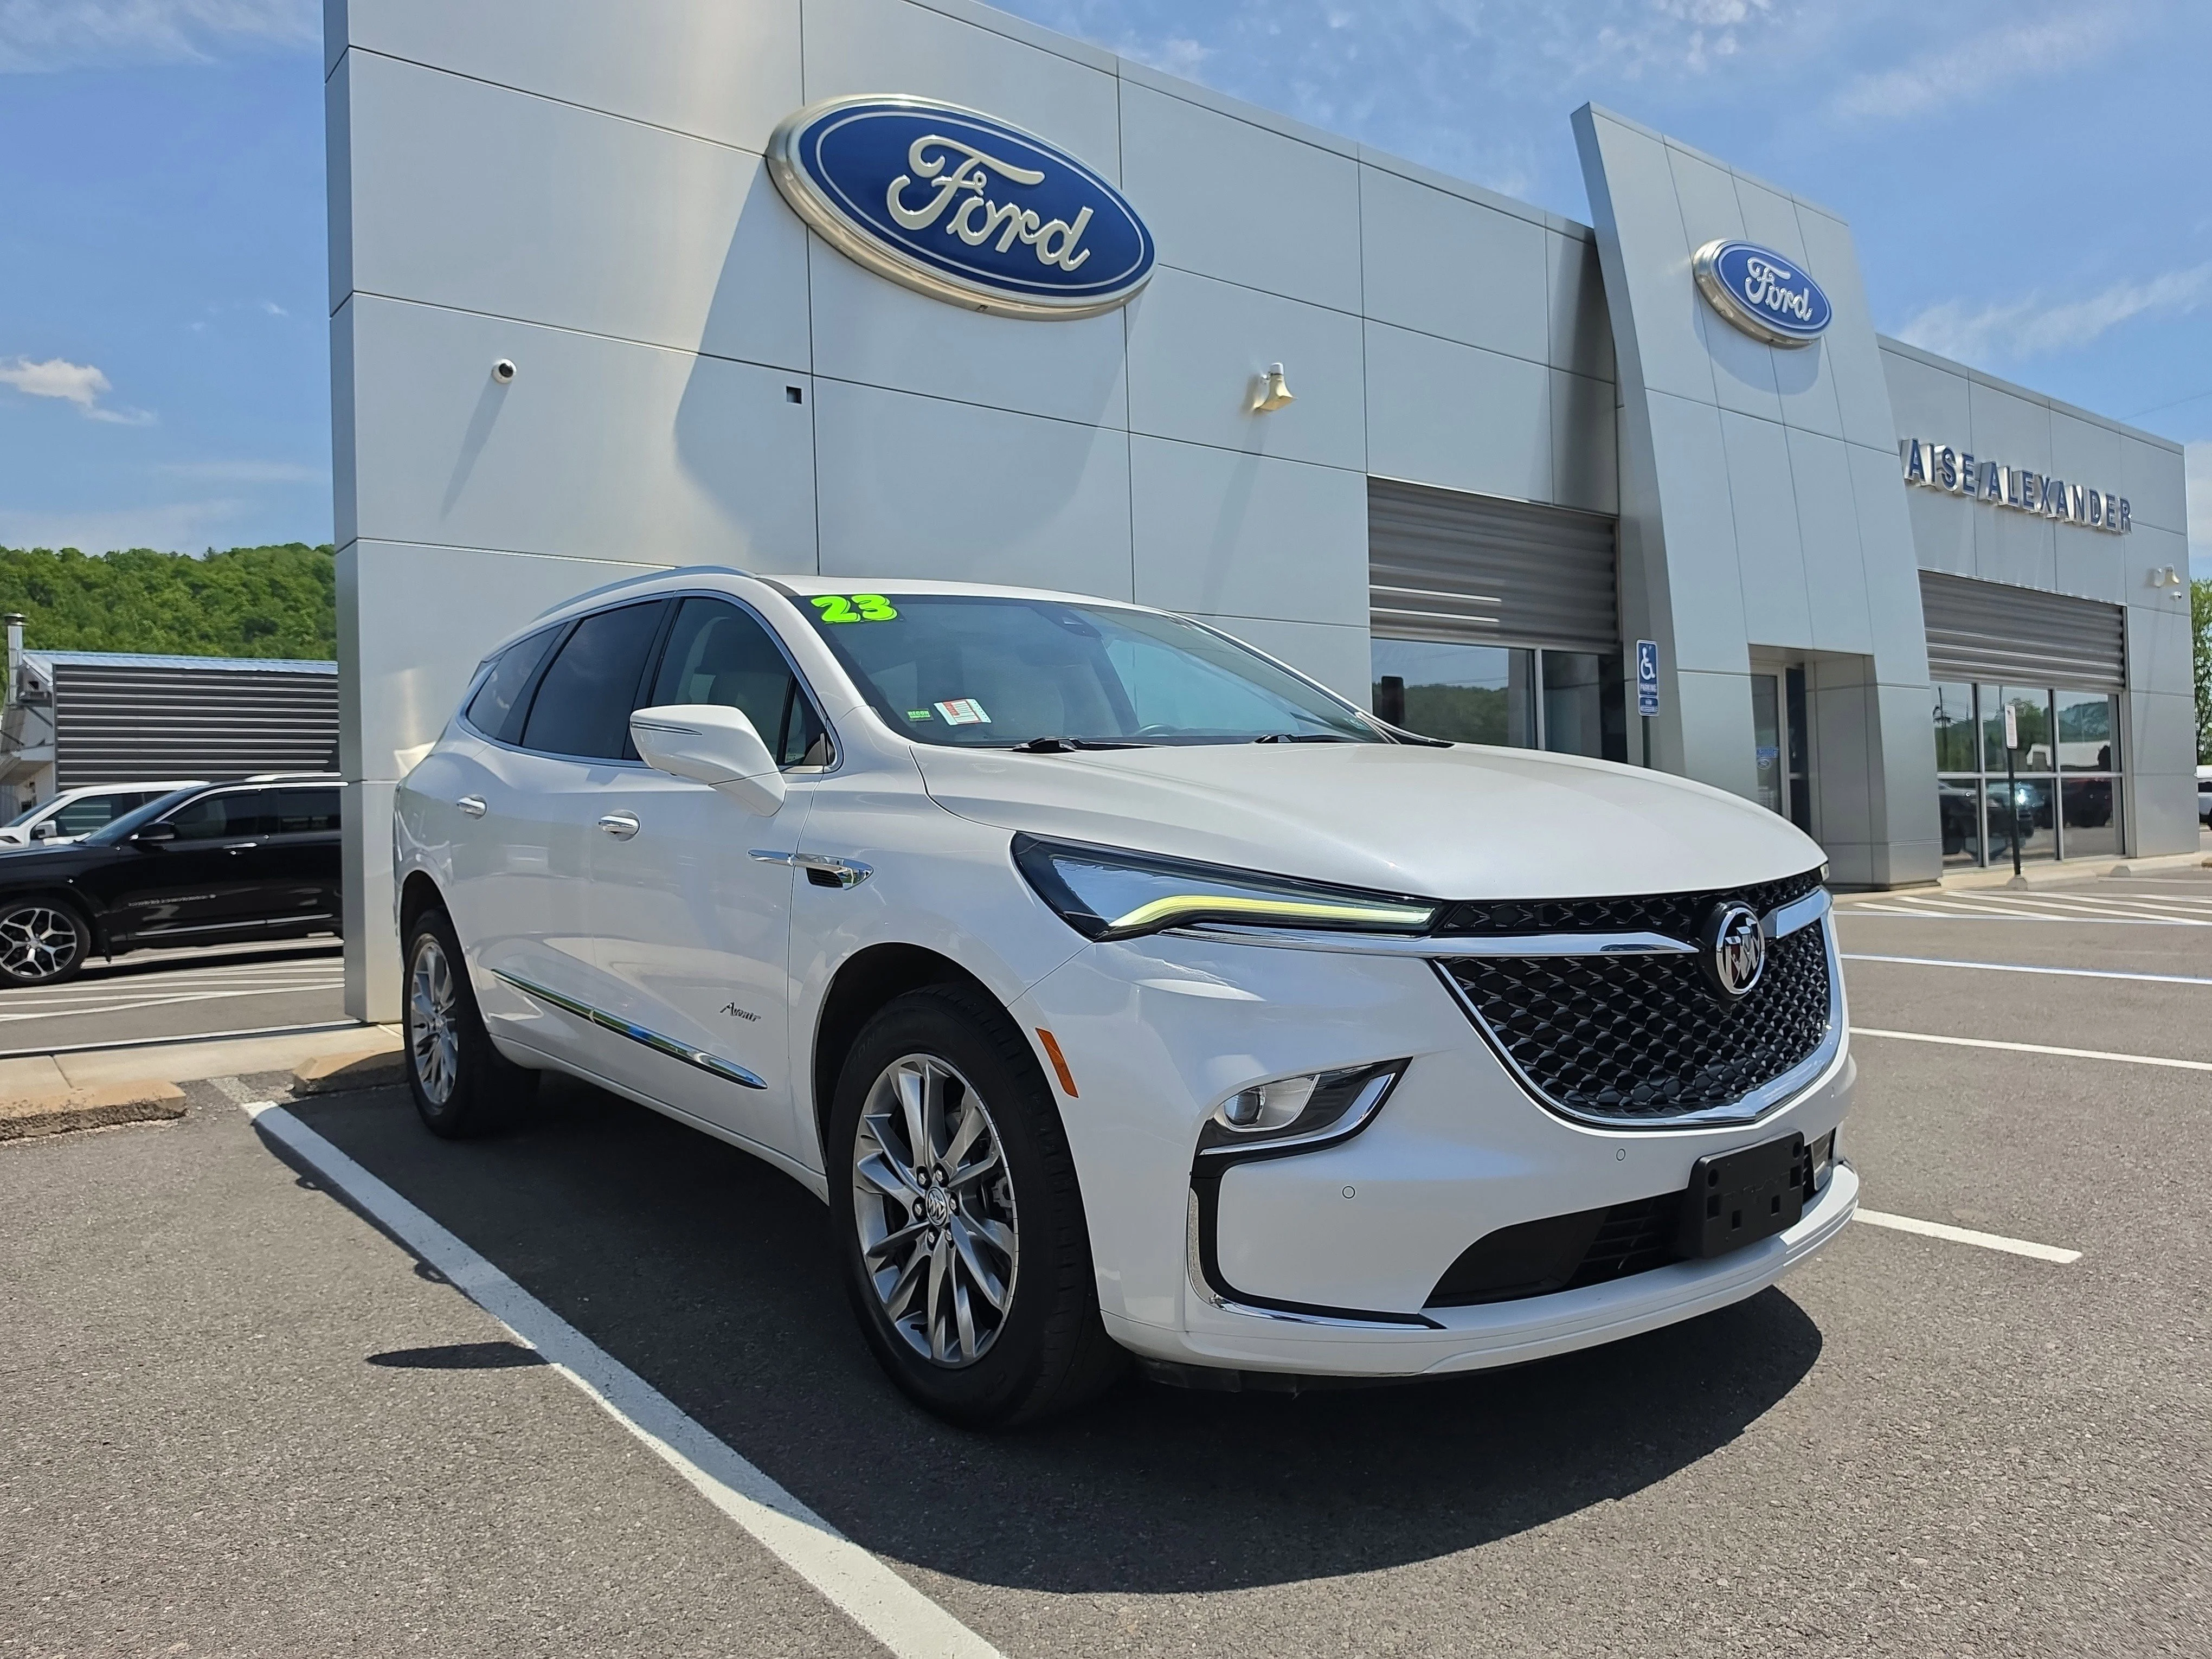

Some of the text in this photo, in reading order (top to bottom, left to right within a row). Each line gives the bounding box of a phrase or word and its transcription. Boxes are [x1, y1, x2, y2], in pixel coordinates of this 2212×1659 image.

[887, 134, 1094, 272] Ford
[1744, 256, 1813, 322] Ford
[1981, 461, 2132, 534] ALEXANDER
[811, 594, 898, 623] 23
